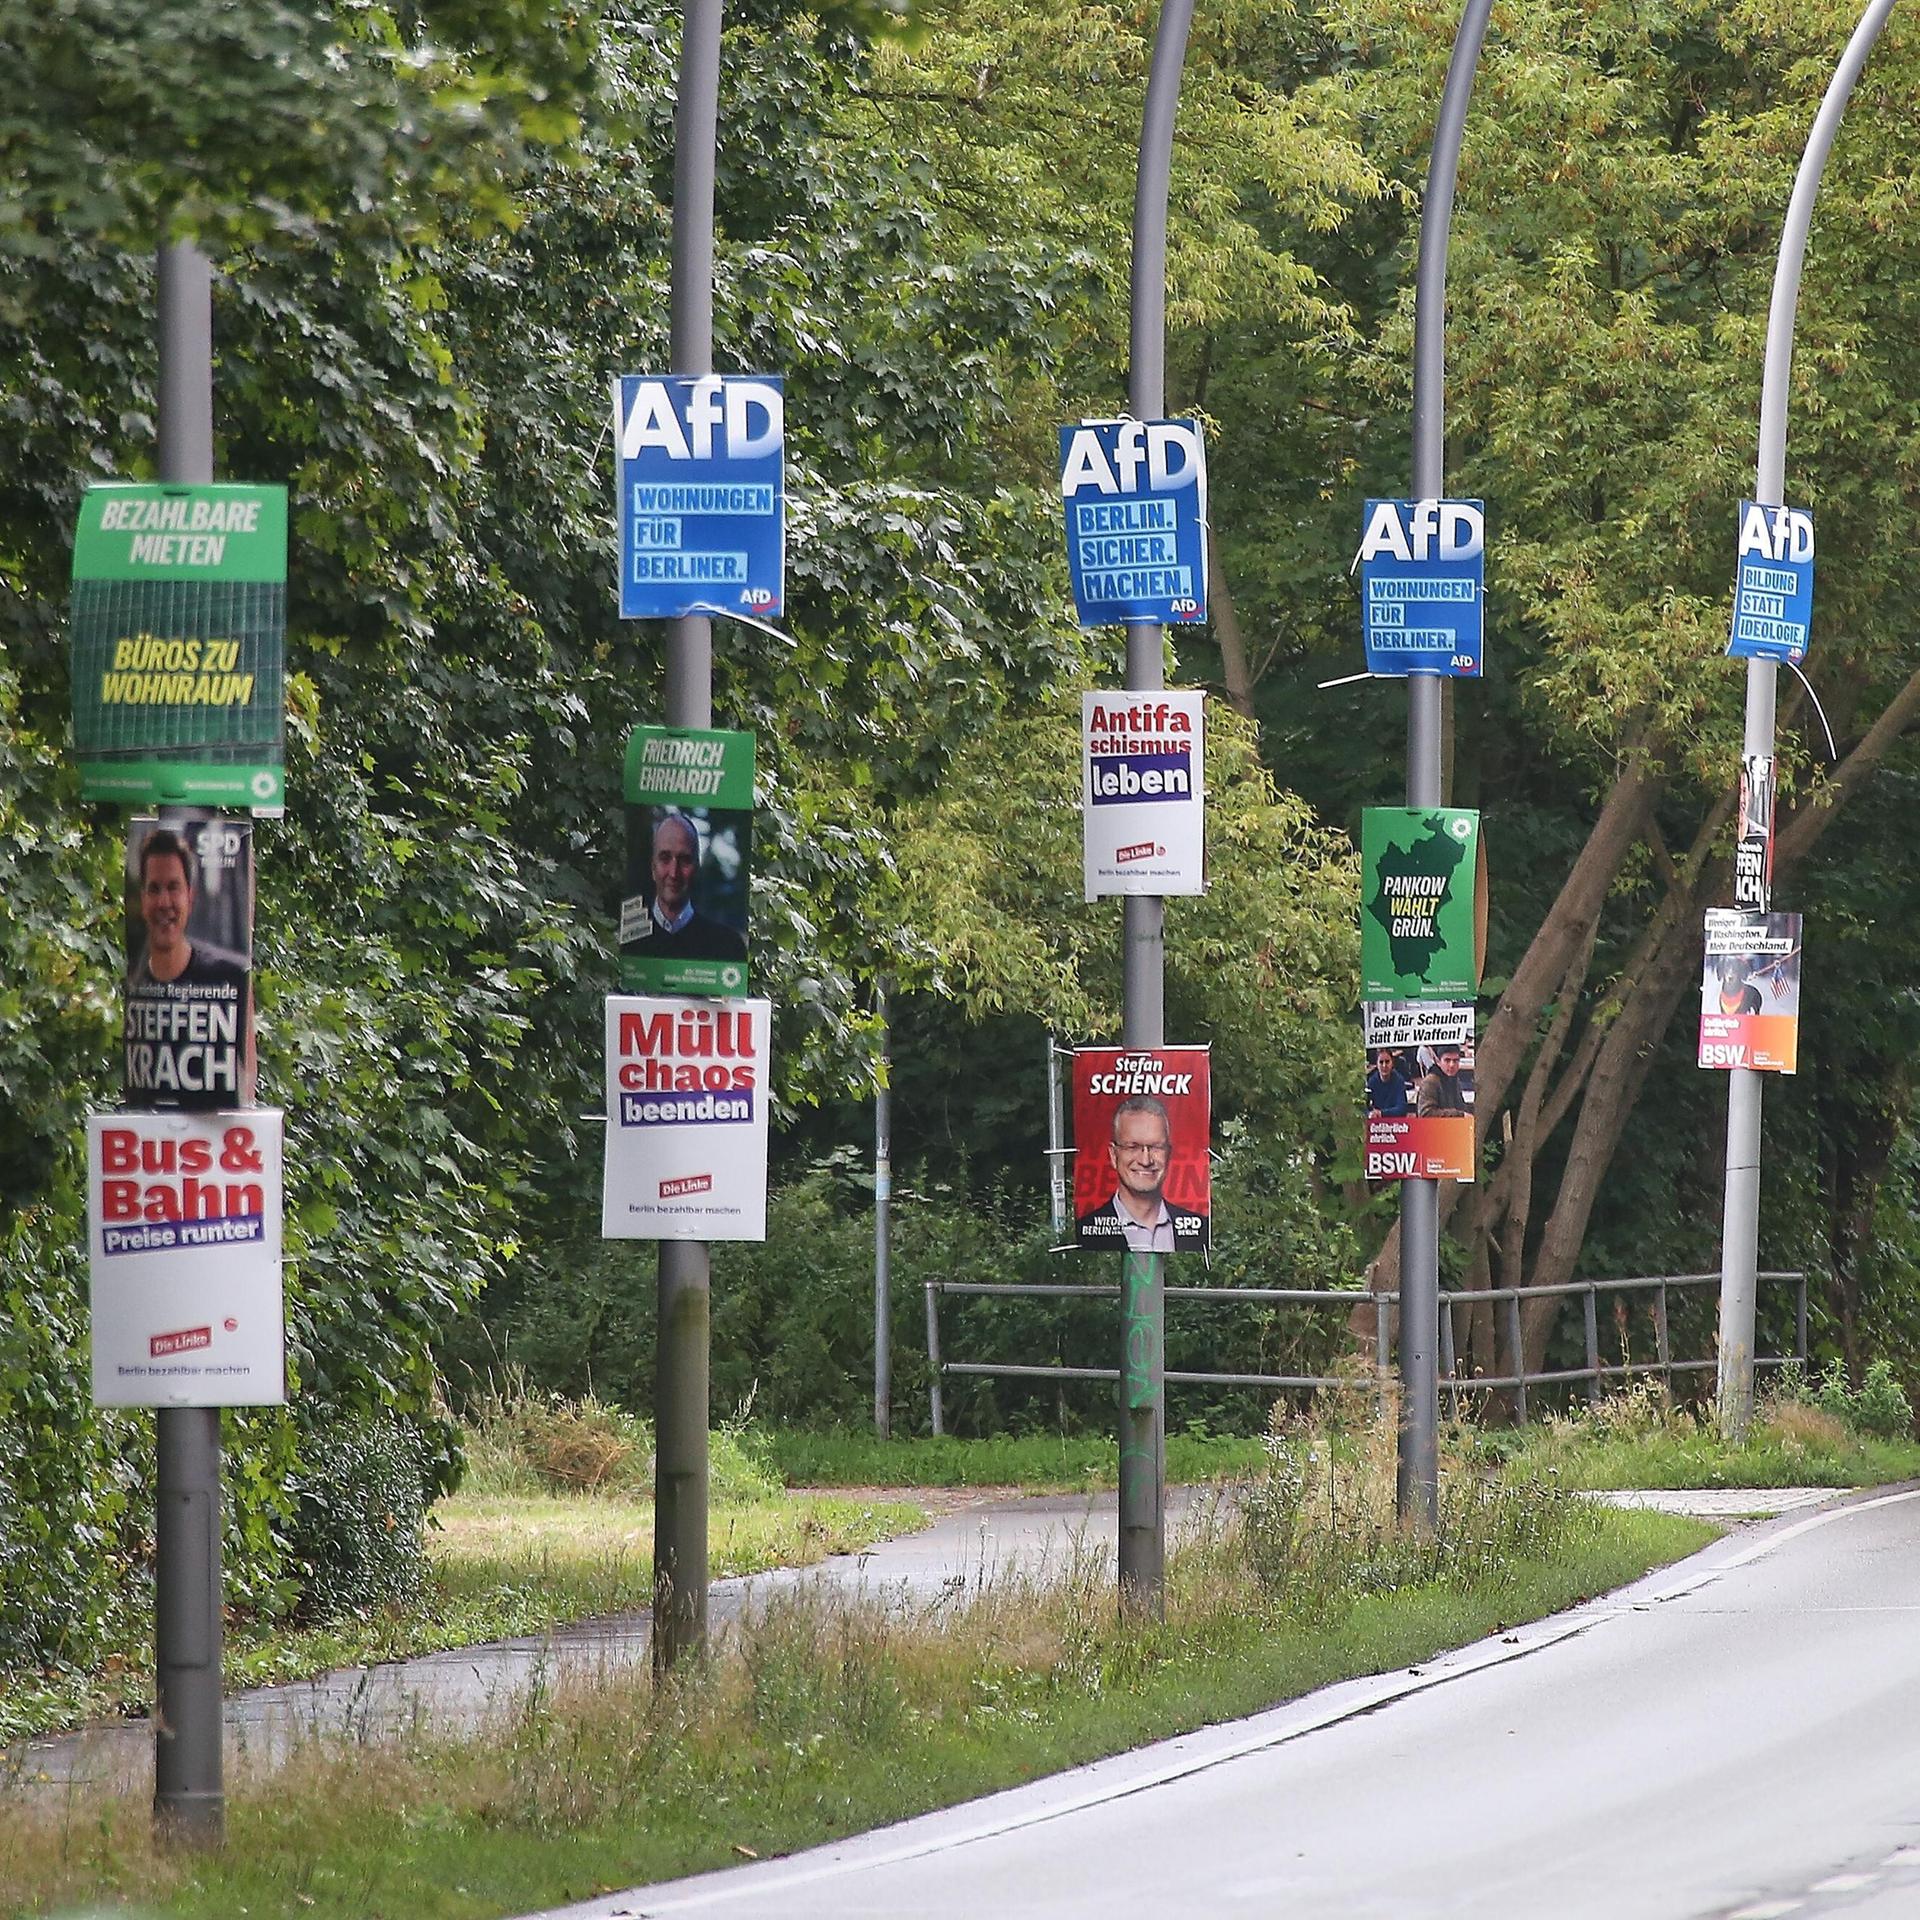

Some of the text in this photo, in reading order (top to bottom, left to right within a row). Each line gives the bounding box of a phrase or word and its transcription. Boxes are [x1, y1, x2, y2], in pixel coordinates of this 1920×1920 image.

[622, 379, 783, 460] AfD
[1061, 423, 1198, 497] AfD
[637, 487, 771, 511] WOHNUNGEN
[100, 499, 263, 532] BEZAHLBARE
[1079, 502, 1174, 533] BERLIN.
[637, 518, 678, 545] FÜR
[1361, 501, 1484, 561] AfD
[1740, 505, 1815, 564] AfD
[129, 534, 226, 566] MIETEN
[1081, 536, 1174, 567] SICHER.
[637, 556, 744, 579] BERLINER.
[1084, 569, 1190, 600] MACHEN.
[1371, 581, 1473, 599] WOHNUNGEN
[1745, 568, 1794, 592] BILDUNG
[740, 589, 772, 604] AfD
[1171, 599, 1198, 613] AfD
[1743, 594, 1782, 616] STATT
[1371, 602, 1401, 623] FÜR
[1372, 630, 1454, 649] BERLINER.
[1740, 618, 1802, 644] IDEOLOGIE.
[113, 632, 240, 672] BÜROS ZU
[1450, 655, 1474, 668] AfD
[102, 673, 254, 706] WOHNRAUM
[1089, 703, 1192, 734] Antifa
[641, 737, 726, 768] FRIEDRICH
[1089, 734, 1192, 754] schismus
[639, 764, 726, 796] EHRHARDT
[1092, 763, 1189, 797] leben
[1384, 876, 1447, 896] PANKOW
[1390, 893, 1440, 917] WÄHLT
[1392, 913, 1434, 938] GRÜN.
[1729, 941, 1789, 951] Deutschland.
[167, 983, 238, 1002] Regierende
[127, 1001, 237, 1043] STEFFEN
[1374, 1012, 1468, 1029] Geld für Schulen
[619, 1009, 756, 1058] Müll
[1369, 1027, 1461, 1045] statt für Waffen!
[1114, 1056, 1164, 1076] Stefan
[1702, 1044, 1745, 1066] BSW
[127, 1044, 237, 1092] KRACH
[618, 1058, 756, 1092] chaos
[1089, 1073, 1193, 1096] SCHENCK
[625, 1095, 749, 1123] beenden
[101, 1127, 264, 1176] Bus &
[1368, 1152, 1417, 1174] BSW
[662, 1178, 709, 1196] Die Linke
[102, 1178, 264, 1223] Bahn
[628, 1203, 742, 1216] Berlin bezahlbar machen
[1082, 1225, 1112, 1236] BERLIN
[1174, 1216, 1202, 1230] SPD
[106, 1220, 260, 1251] Preise runter
[118, 1365, 146, 1377] Berlin
[204, 1365, 251, 1377] machen
